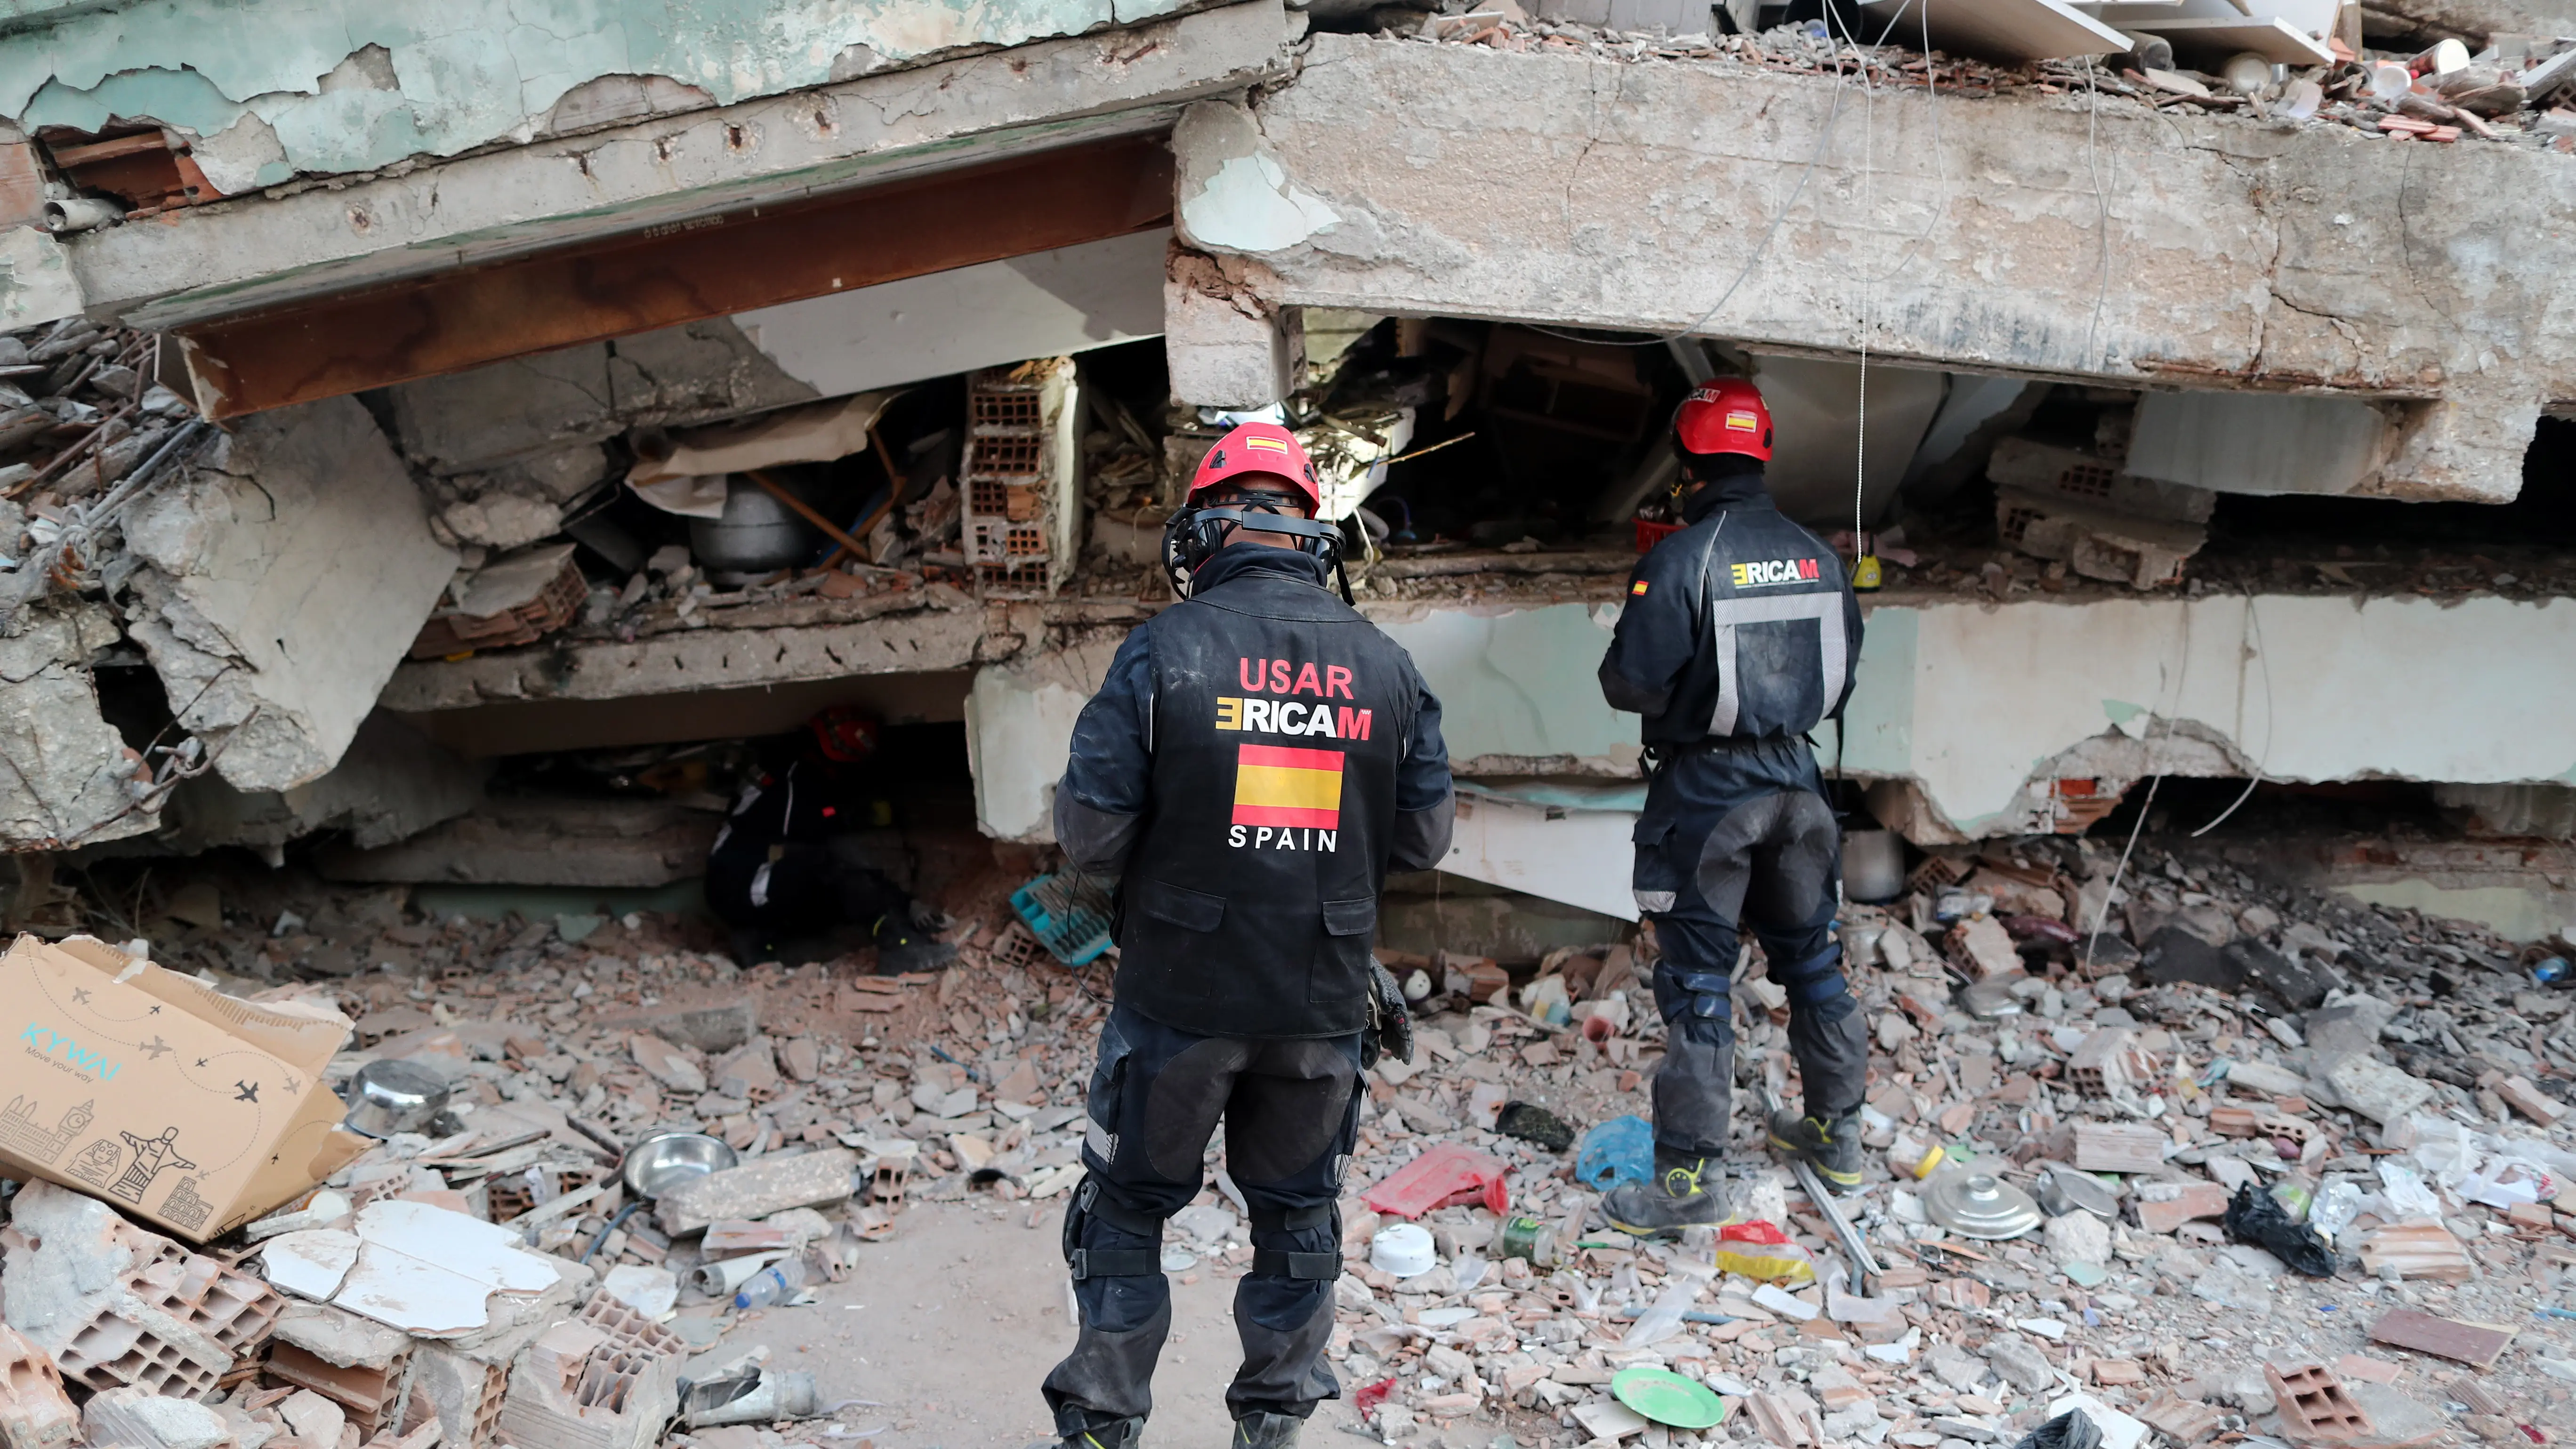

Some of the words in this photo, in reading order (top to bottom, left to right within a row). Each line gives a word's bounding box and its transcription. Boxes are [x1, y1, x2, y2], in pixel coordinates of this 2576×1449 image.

[1731, 558, 1820, 586] ERICAM
[1240, 657, 1354, 700] USAR
[1215, 696, 1372, 741] ERICAM
[1228, 825, 1337, 853] SPAIN
[25, 1046, 51, 1063] Move
[52, 1060, 73, 1073] your
[74, 1071, 94, 1084] way
